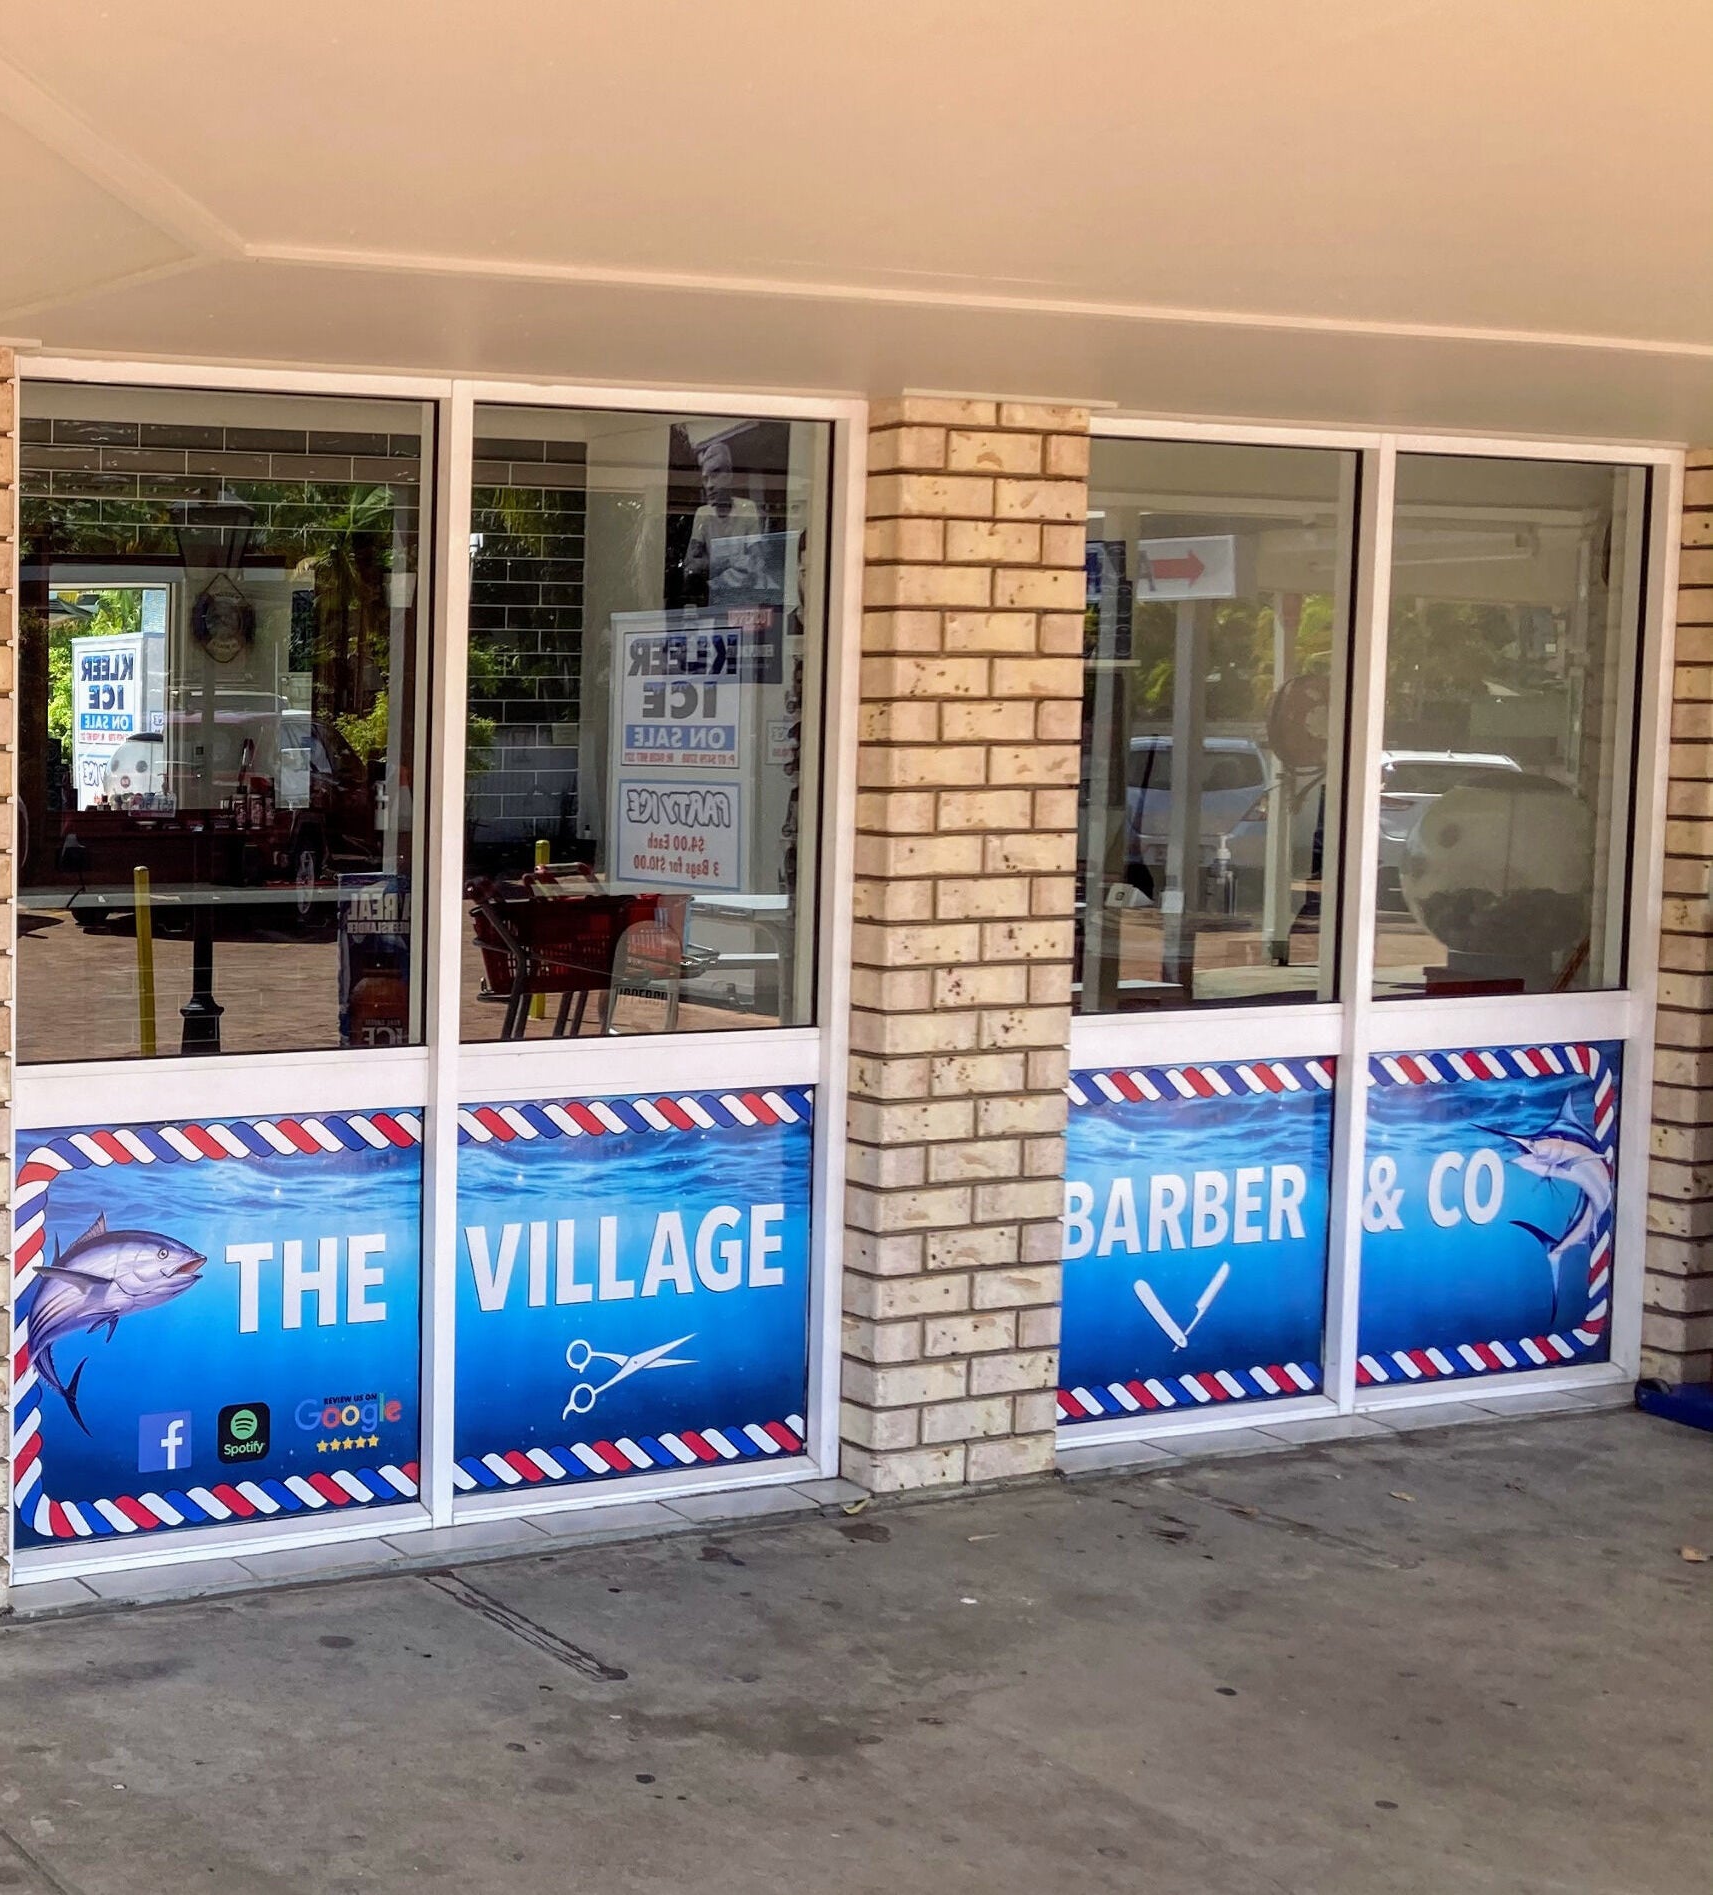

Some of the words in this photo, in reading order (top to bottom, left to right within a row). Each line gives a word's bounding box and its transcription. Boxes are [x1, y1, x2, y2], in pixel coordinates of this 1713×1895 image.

[223, 1232, 387, 1334] THE
[463, 1202, 786, 1312] VILLAGE
[1062, 1164, 1307, 1260] BARBER
[1362, 1154, 1405, 1234] &
[1428, 1148, 1506, 1229] CO
[294, 1392, 402, 1432] Google
[323, 1394, 352, 1405] REVIEW
[353, 1394, 364, 1402] US
[365, 1392, 378, 1402] ON
[224, 1440, 265, 1457] Spotify
